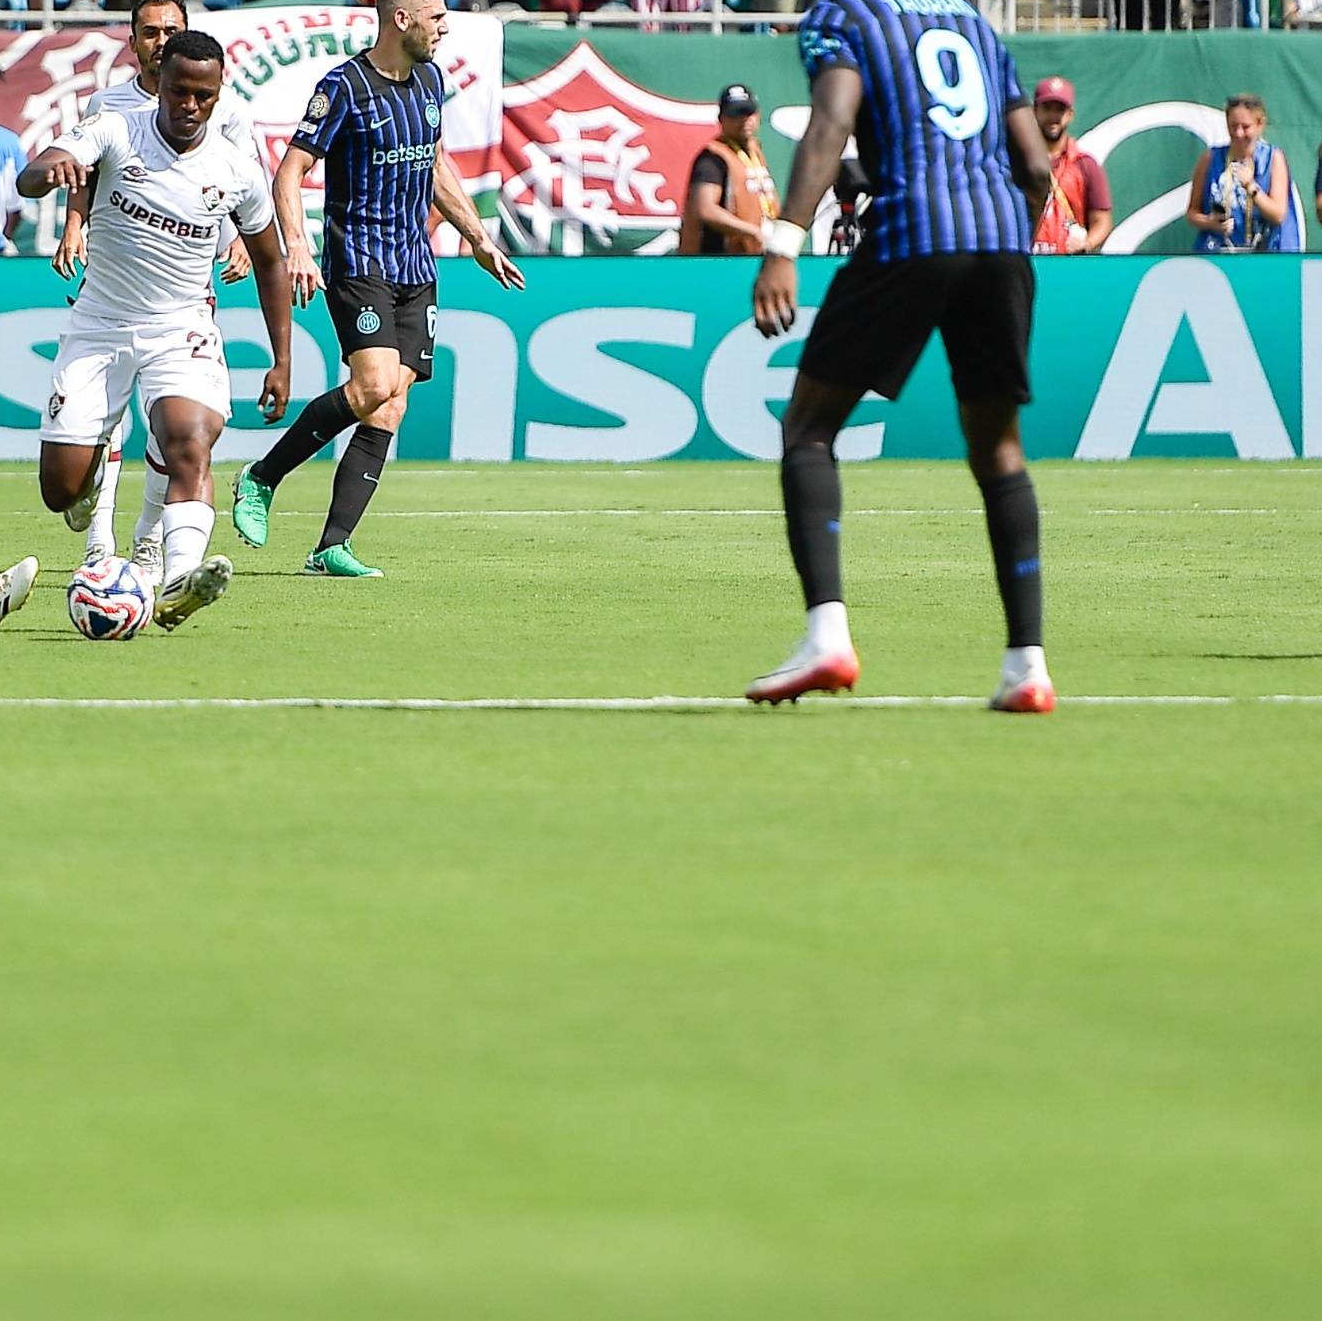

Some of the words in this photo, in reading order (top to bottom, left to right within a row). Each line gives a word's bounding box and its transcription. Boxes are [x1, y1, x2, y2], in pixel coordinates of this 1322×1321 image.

[915, 28, 989, 141] 9
[372, 142, 435, 165] betsso
[109, 190, 215, 239] SUPERBET
